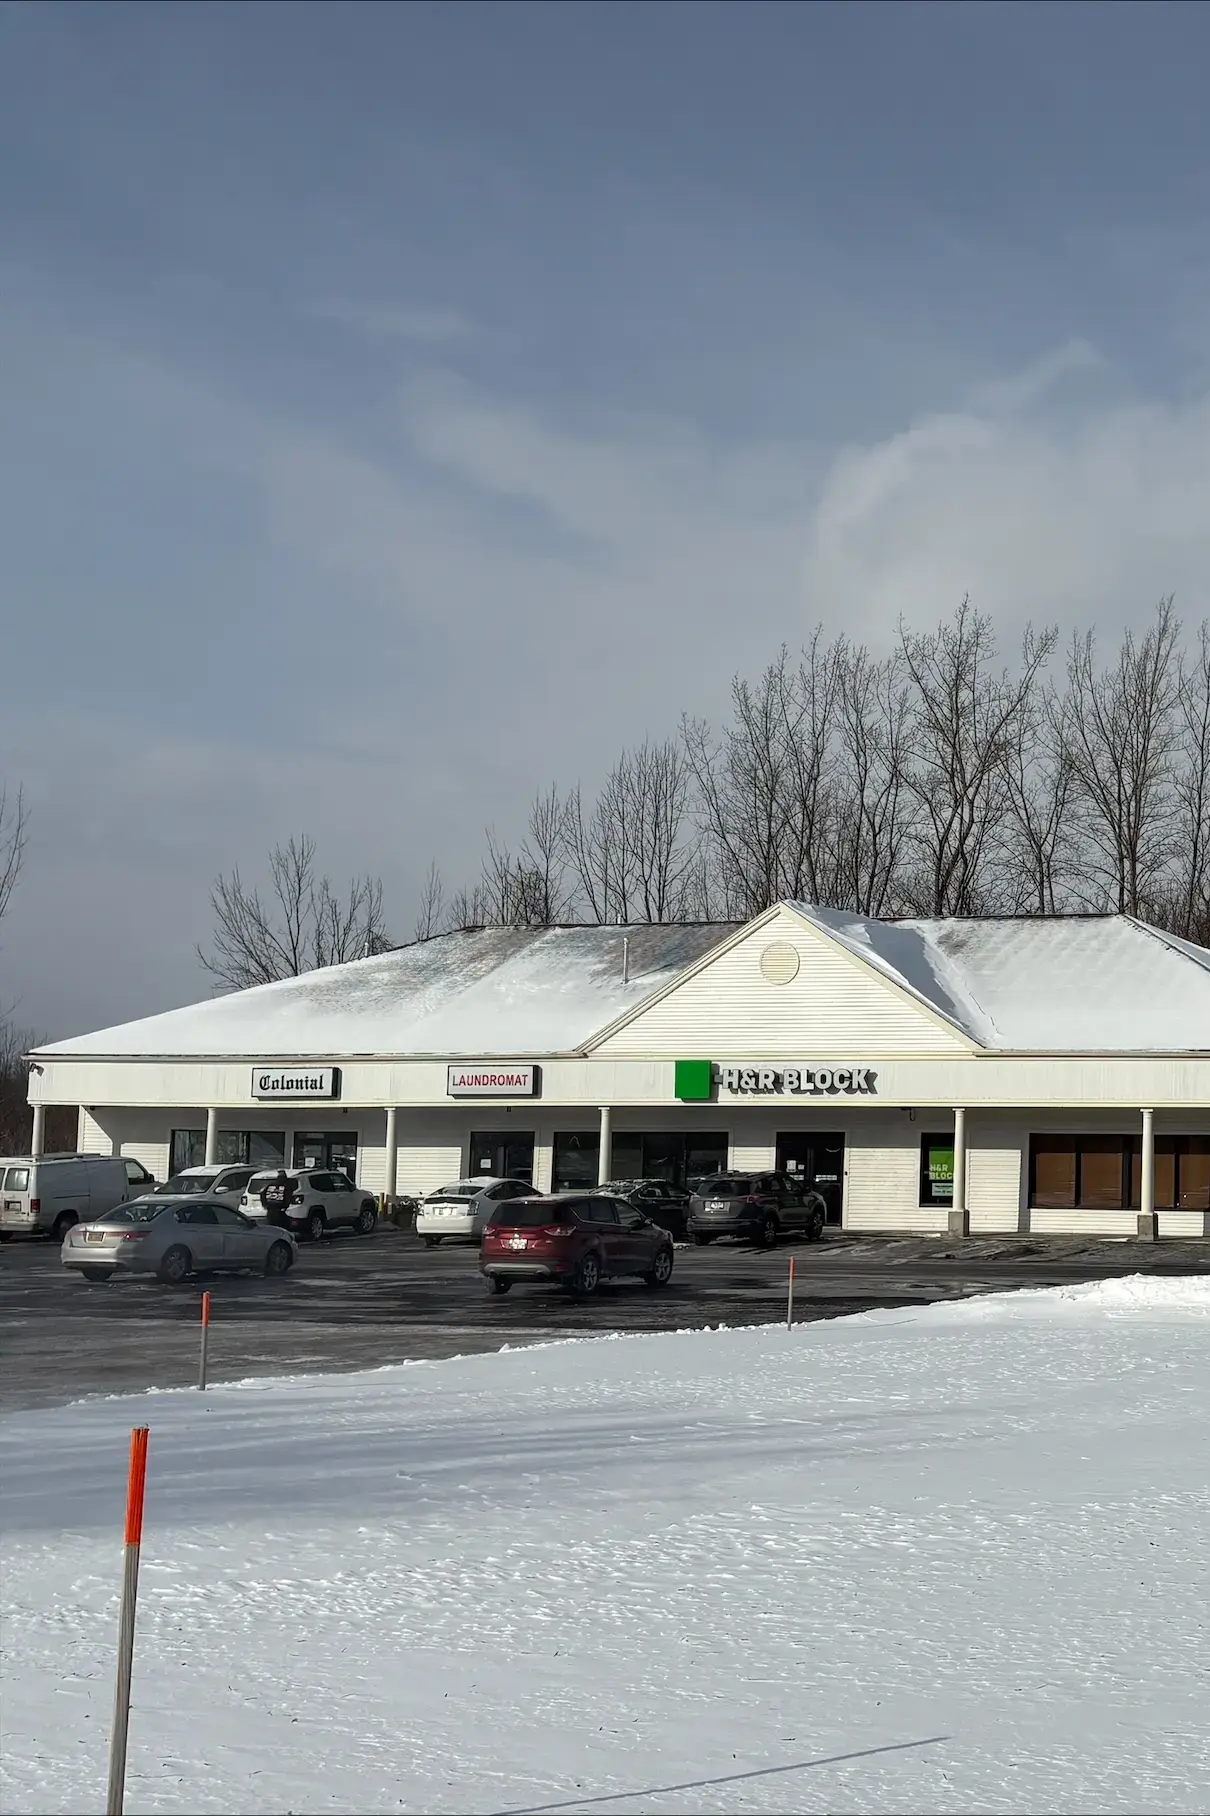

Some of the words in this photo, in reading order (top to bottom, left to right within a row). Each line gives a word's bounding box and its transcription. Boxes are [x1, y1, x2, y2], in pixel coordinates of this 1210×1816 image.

[259, 1074, 324, 1091] Colonial
[452, 1074, 528, 1087] LAUNDROMAT
[722, 1068, 775, 1089] H&R
[783, 1068, 871, 1090] BLOCK
[930, 1172, 953, 1180] BLOC
